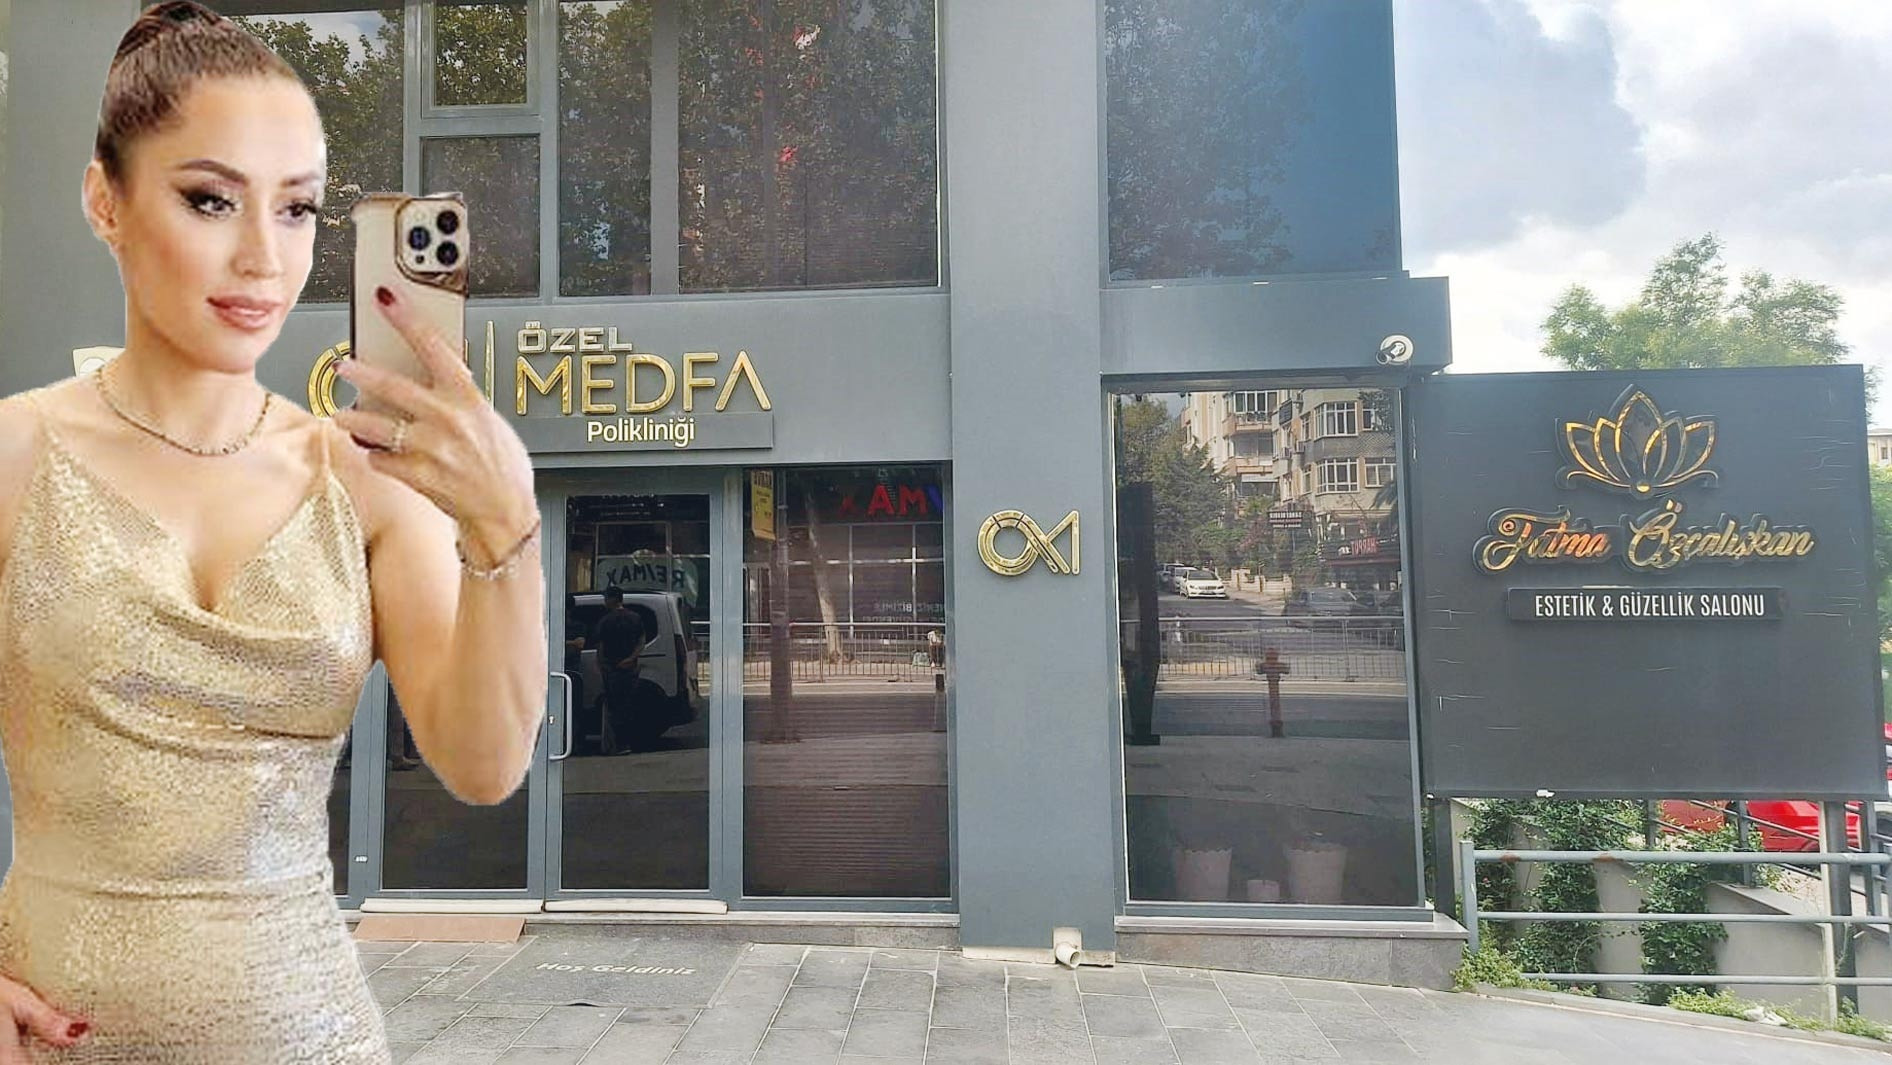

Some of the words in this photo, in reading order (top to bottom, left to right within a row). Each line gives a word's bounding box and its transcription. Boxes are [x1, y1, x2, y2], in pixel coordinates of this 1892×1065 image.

[517, 320, 633, 353] ÖZEL
[516, 350, 772, 416] MEDFA
[587, 415, 695, 448] Polikliniği
[1482, 505, 1610, 571] Fatma
[1534, 593, 1596, 617] ESTETİK
[1602, 594, 1614, 617] &
[1619, 592, 1695, 617] GÜZELLİK
[1700, 593, 1765, 616] SALONU
